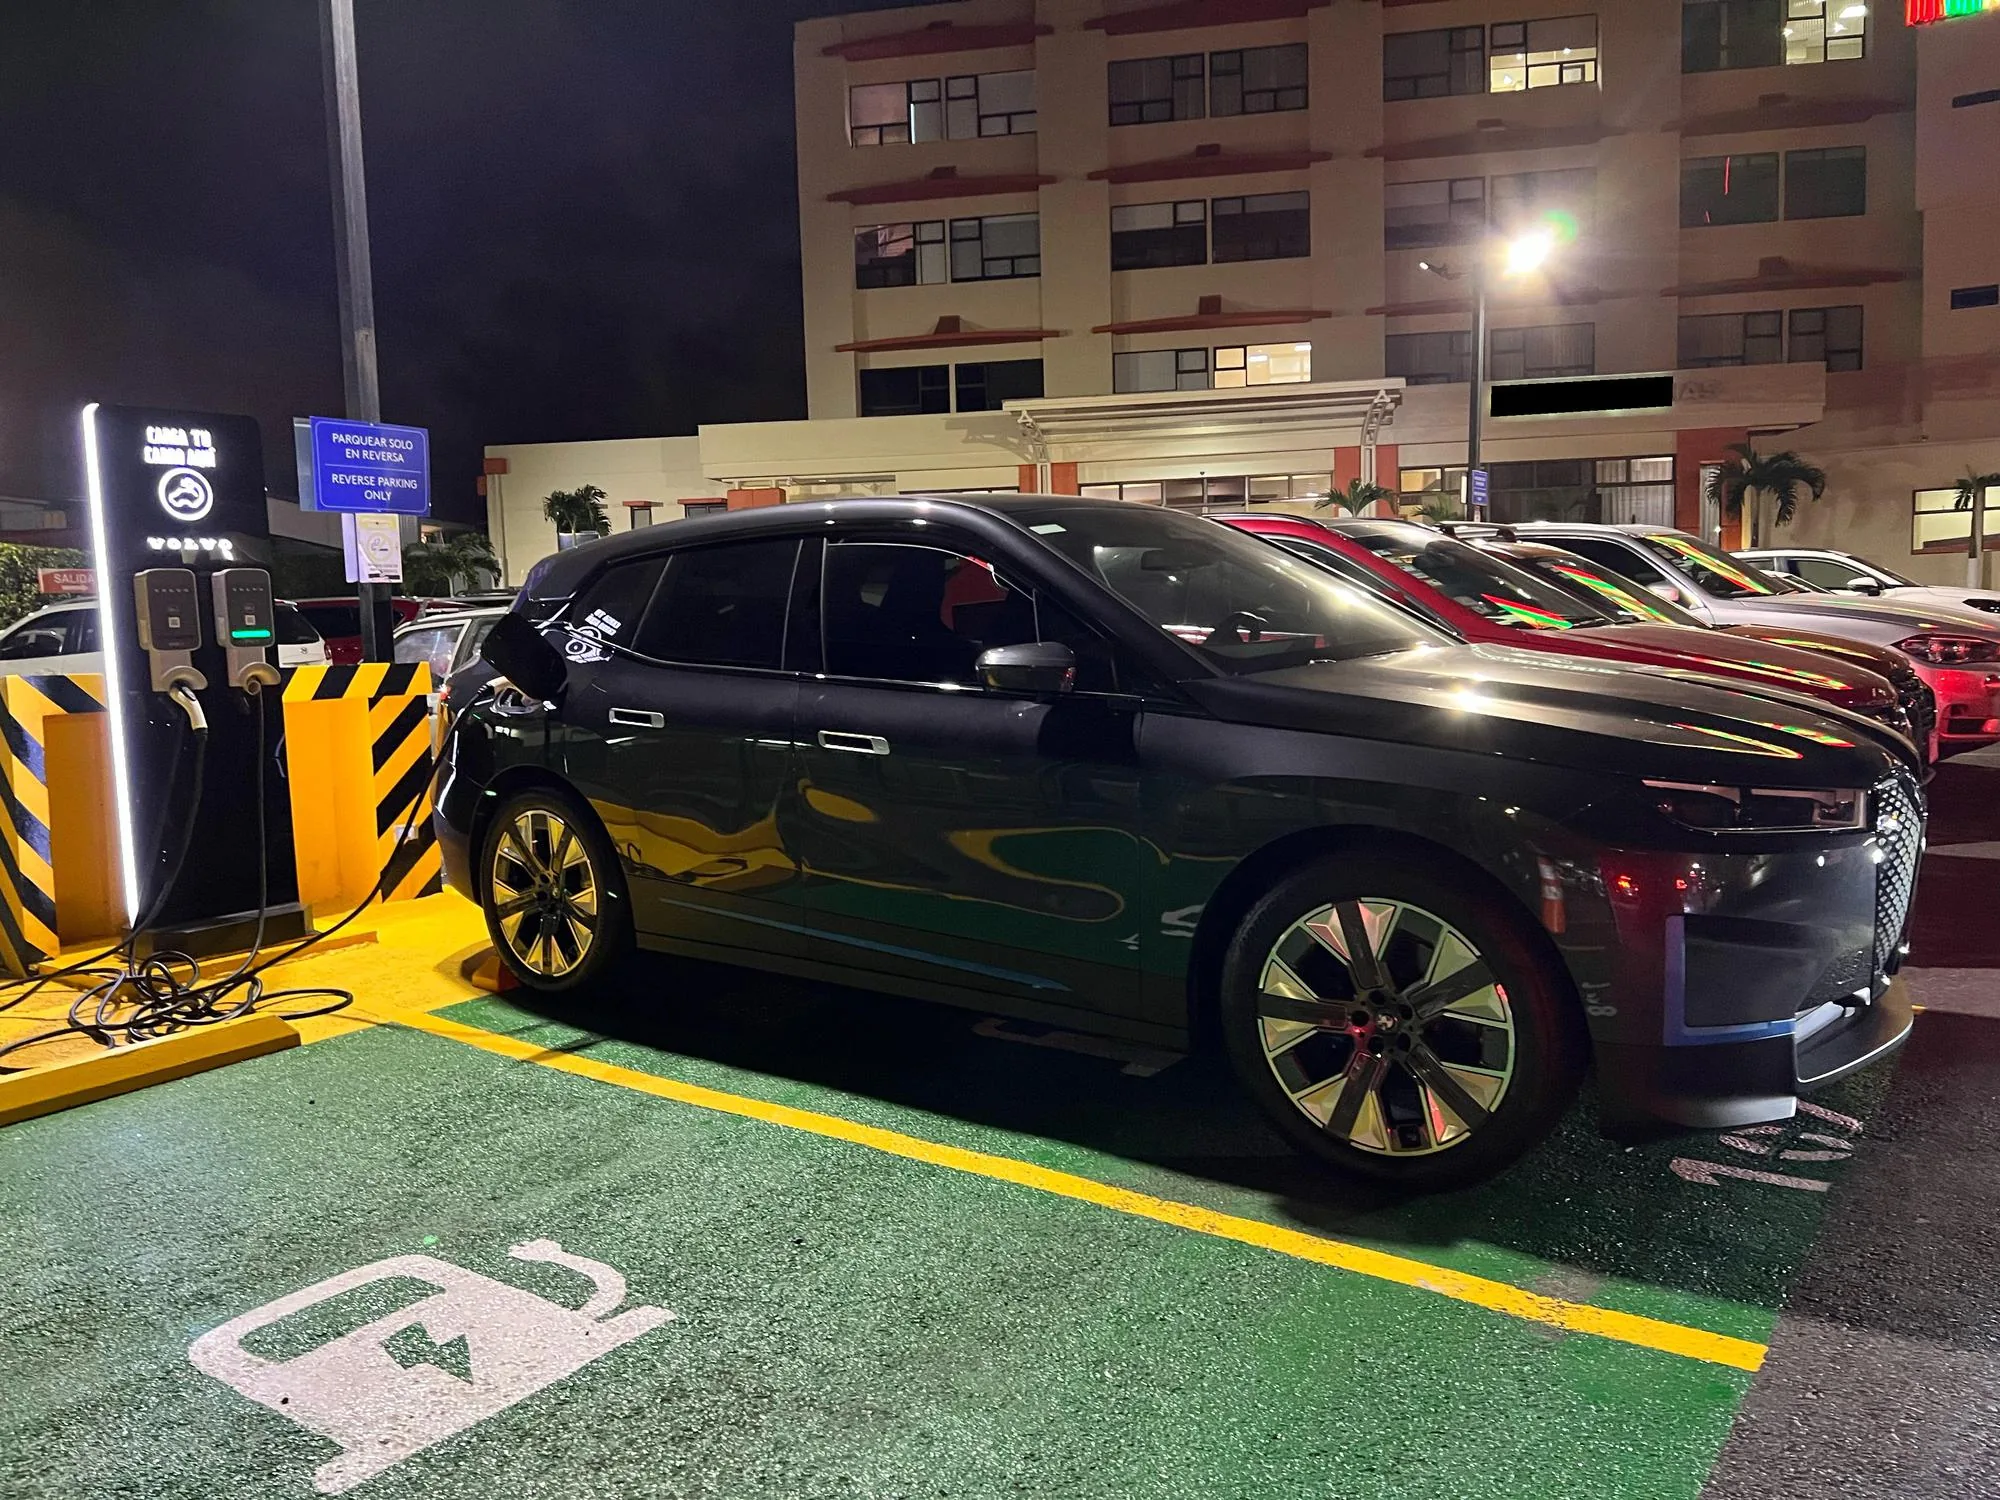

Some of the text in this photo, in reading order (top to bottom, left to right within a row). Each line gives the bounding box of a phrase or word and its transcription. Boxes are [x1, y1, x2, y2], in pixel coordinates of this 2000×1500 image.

[332, 433, 414, 451] PARQUEAR SOLO
[345, 448, 405, 463] EN REVERSA
[331, 473, 418, 489] REVERSE PARKING
[364, 490, 392, 502] ONLY
[146, 536, 233, 551] VOLVO
[53, 573, 95, 584] SALIDA
